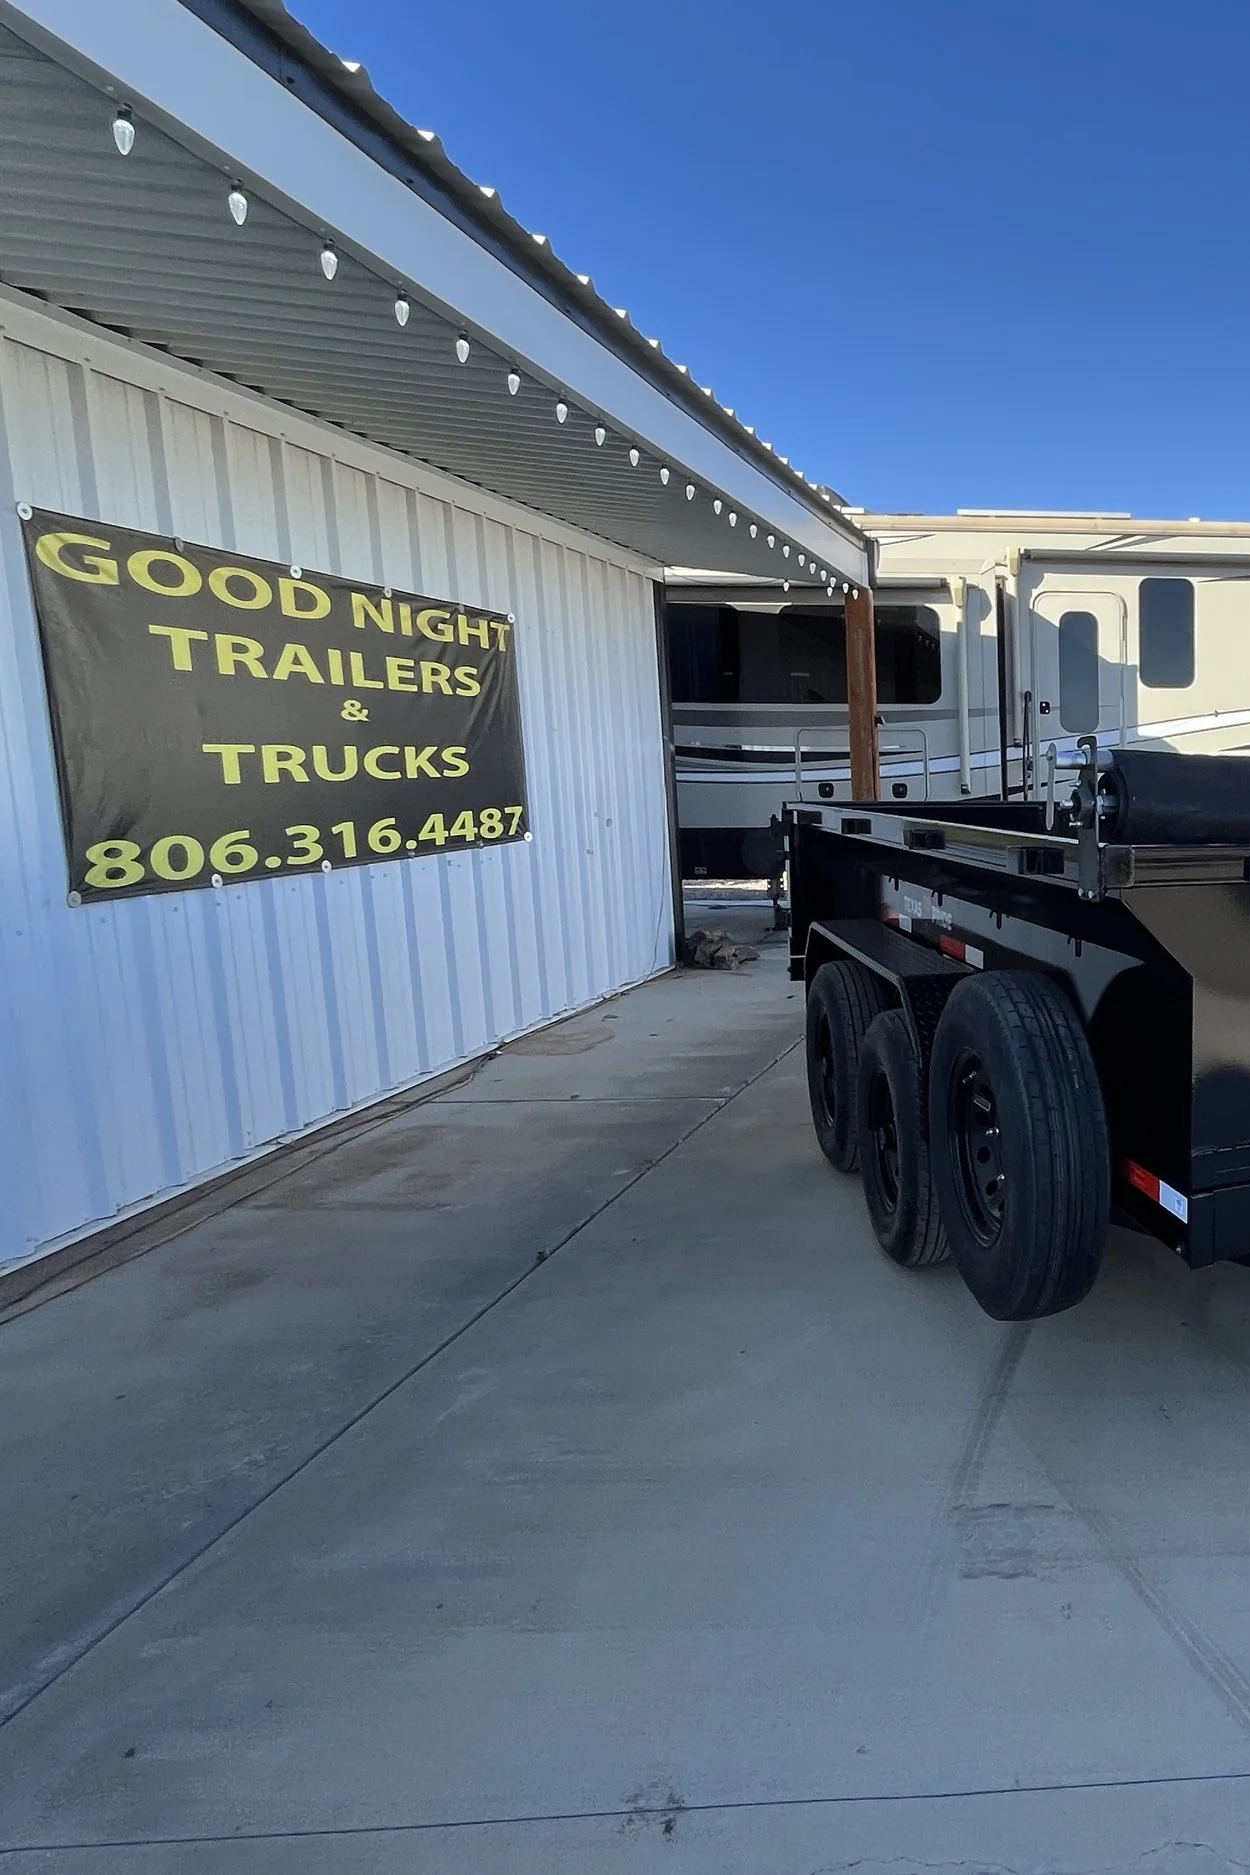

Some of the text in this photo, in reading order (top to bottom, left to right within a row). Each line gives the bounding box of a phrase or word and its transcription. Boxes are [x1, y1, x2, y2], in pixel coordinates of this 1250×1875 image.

[36, 532, 511, 652] GOOD NIGHT
[149, 625, 481, 697] TRAILERS
[341, 699, 369, 722] &
[202, 743, 470, 785] TRUCKS
[85, 806, 524, 887] 806.316.4487
